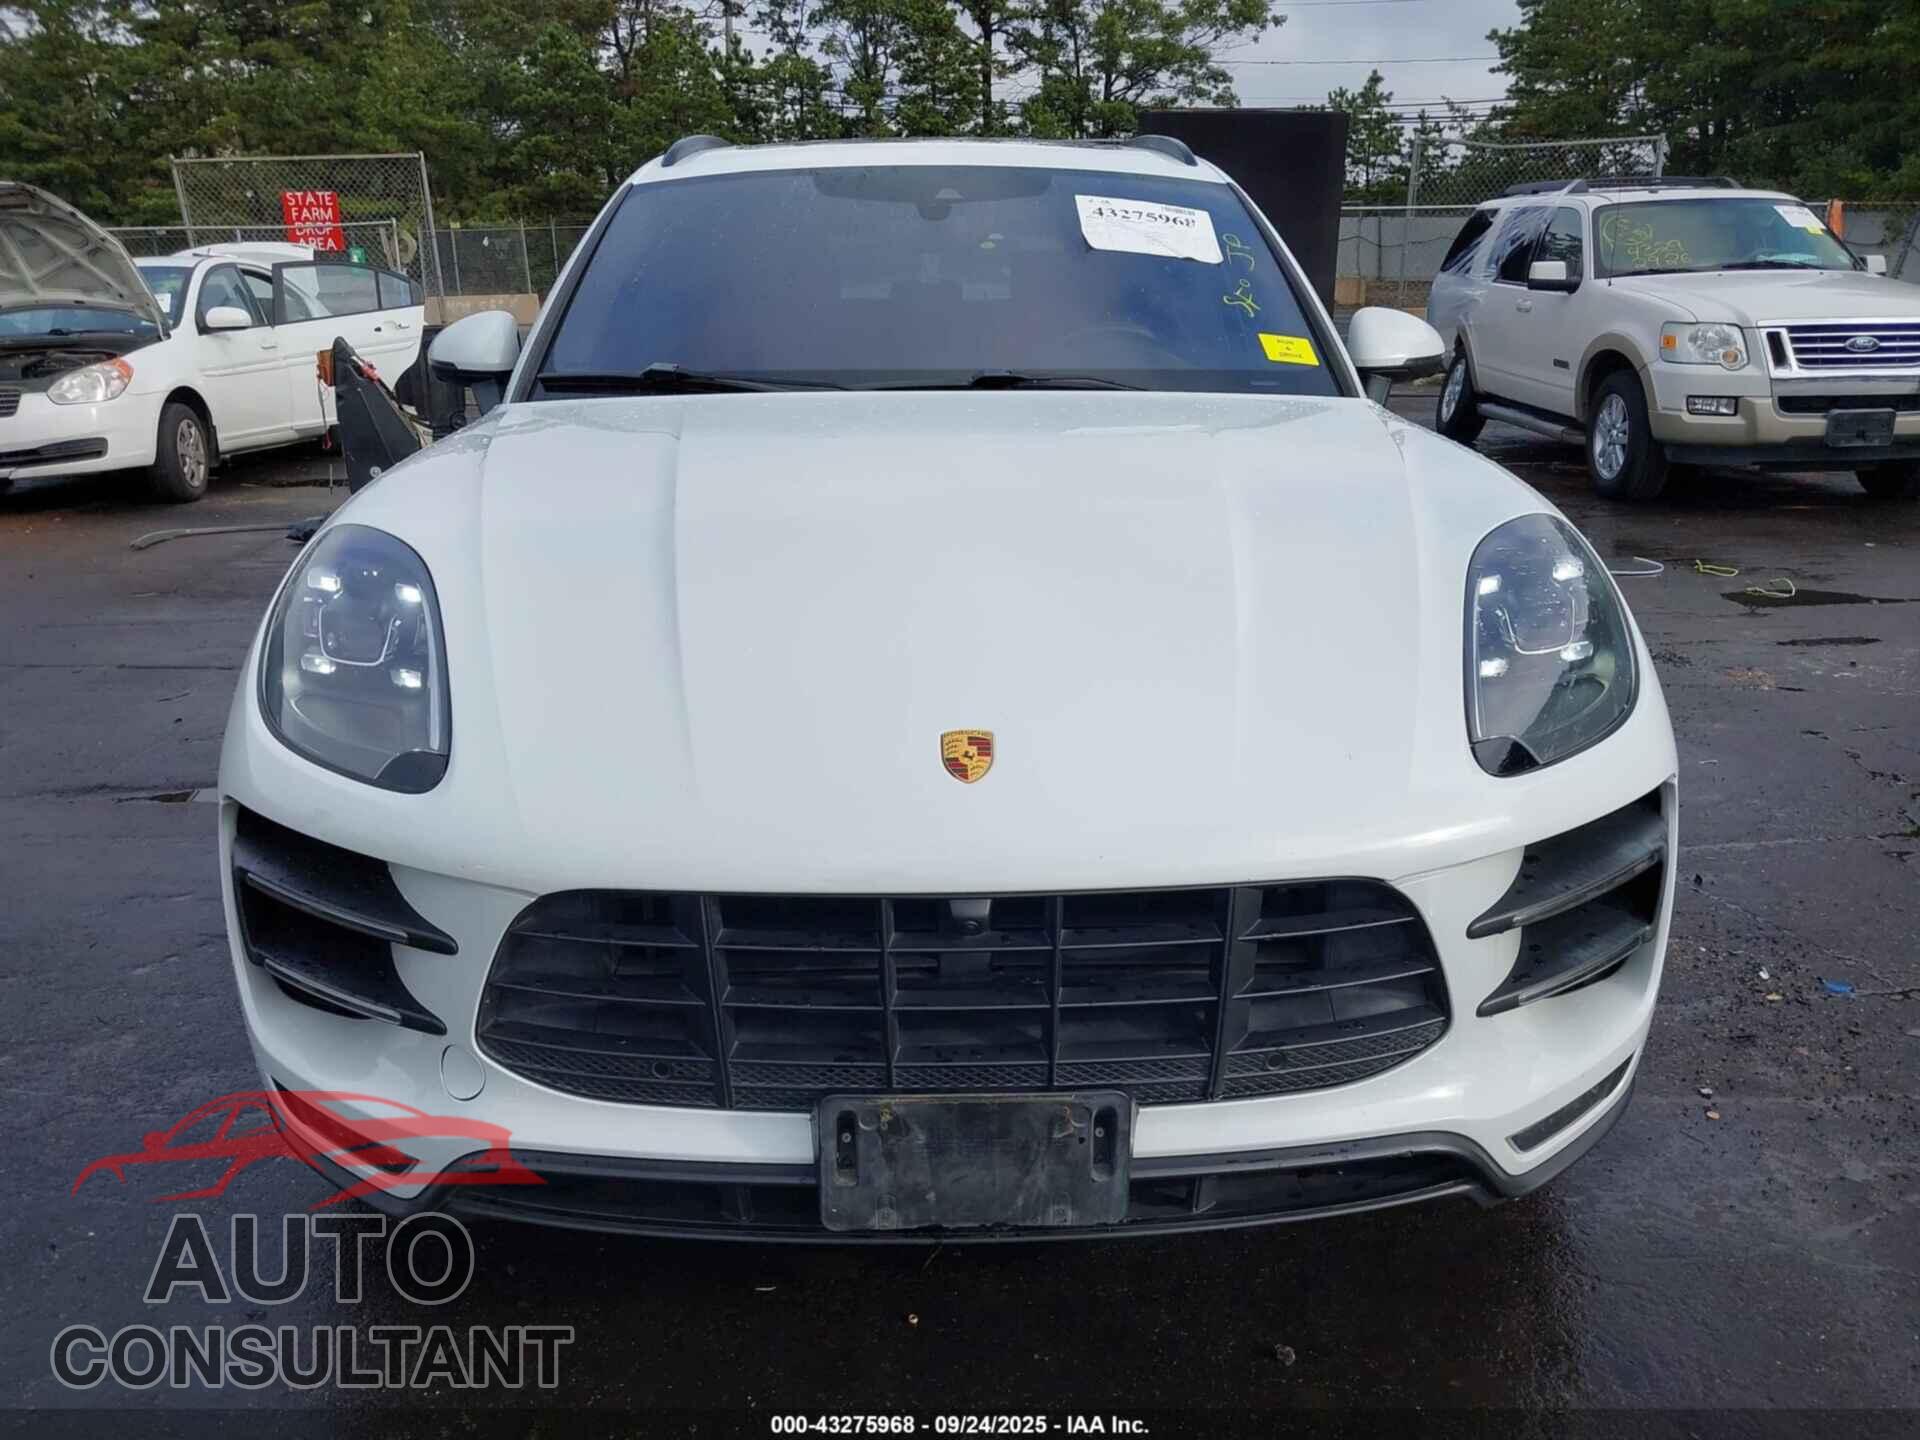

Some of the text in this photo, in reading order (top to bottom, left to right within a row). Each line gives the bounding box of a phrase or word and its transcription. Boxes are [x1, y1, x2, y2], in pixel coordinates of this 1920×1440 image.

[286, 191, 334, 206] STATE
[291, 207, 334, 221] FARM
[1092, 206, 1196, 227] 43275968
[295, 222, 334, 236] DROP
[300, 238, 338, 250] AREA
